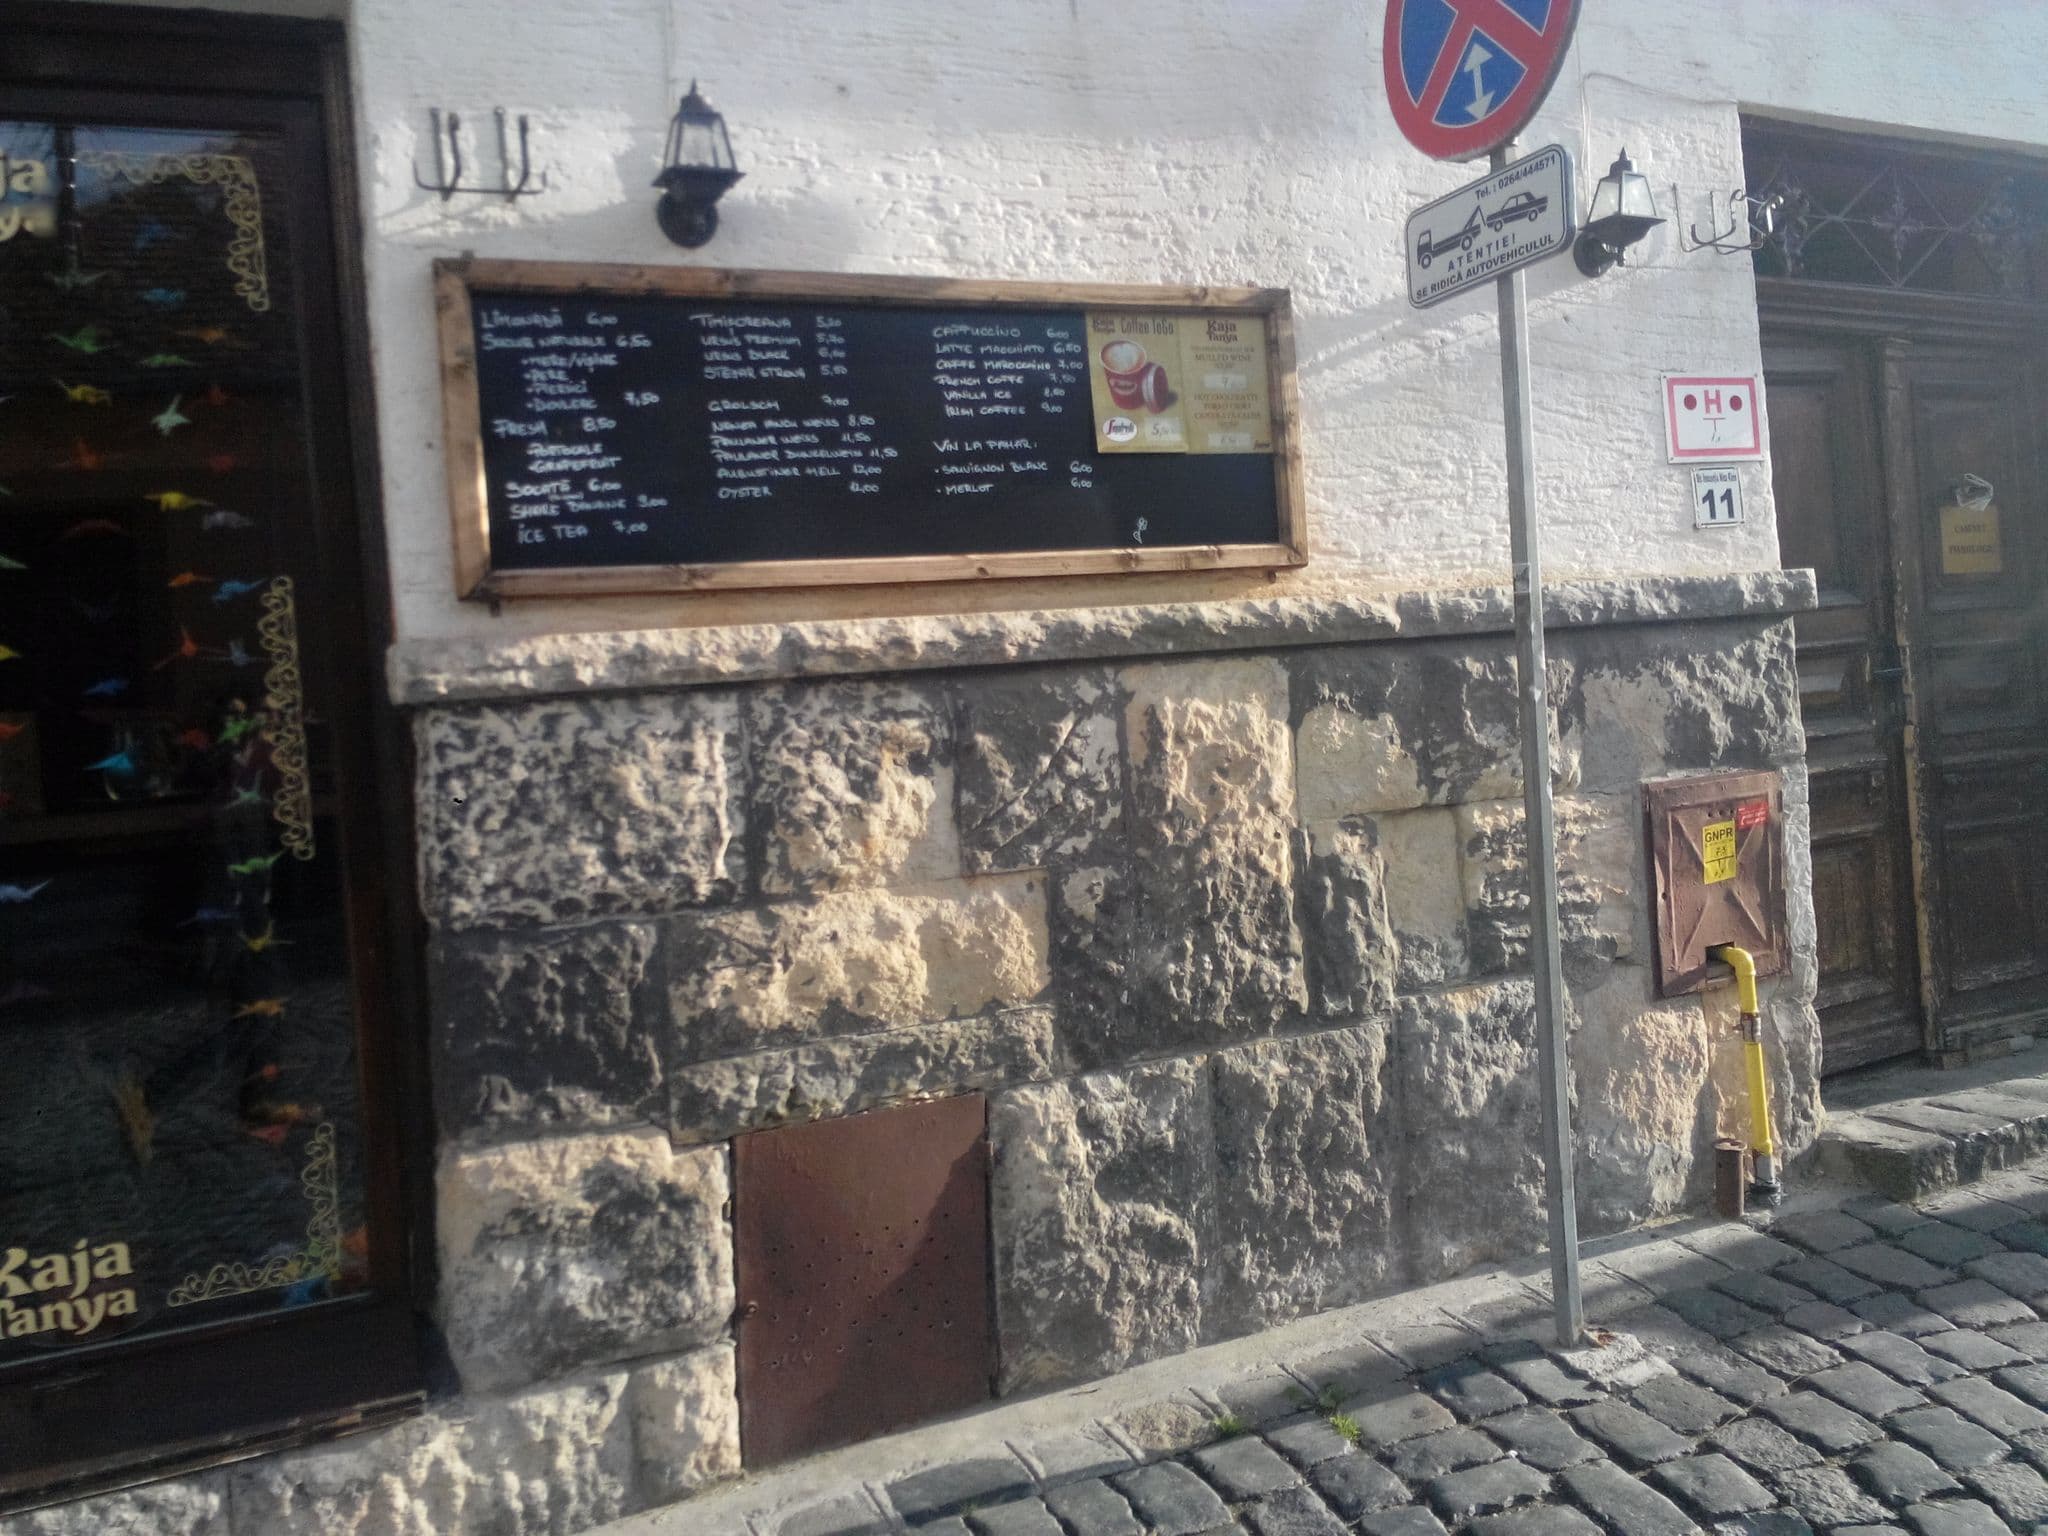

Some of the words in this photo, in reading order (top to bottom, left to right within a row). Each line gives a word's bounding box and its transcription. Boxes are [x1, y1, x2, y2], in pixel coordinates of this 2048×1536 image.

[1416, 287, 1429, 300] SE
[1465, 234, 1555, 279] AUTOVEHICULUL
[1206, 319, 1238, 334] Kaja
[1703, 390, 1723, 414] H
[965, 441, 983, 453] LA
[1008, 460, 1050, 473] BLANC
[717, 486, 773, 500] OYSTER
[944, 483, 996, 496] MERLOT
[1702, 487, 1735, 520] 11
[551, 523, 590, 540] TEA
[1704, 827, 1734, 843] GNPR
